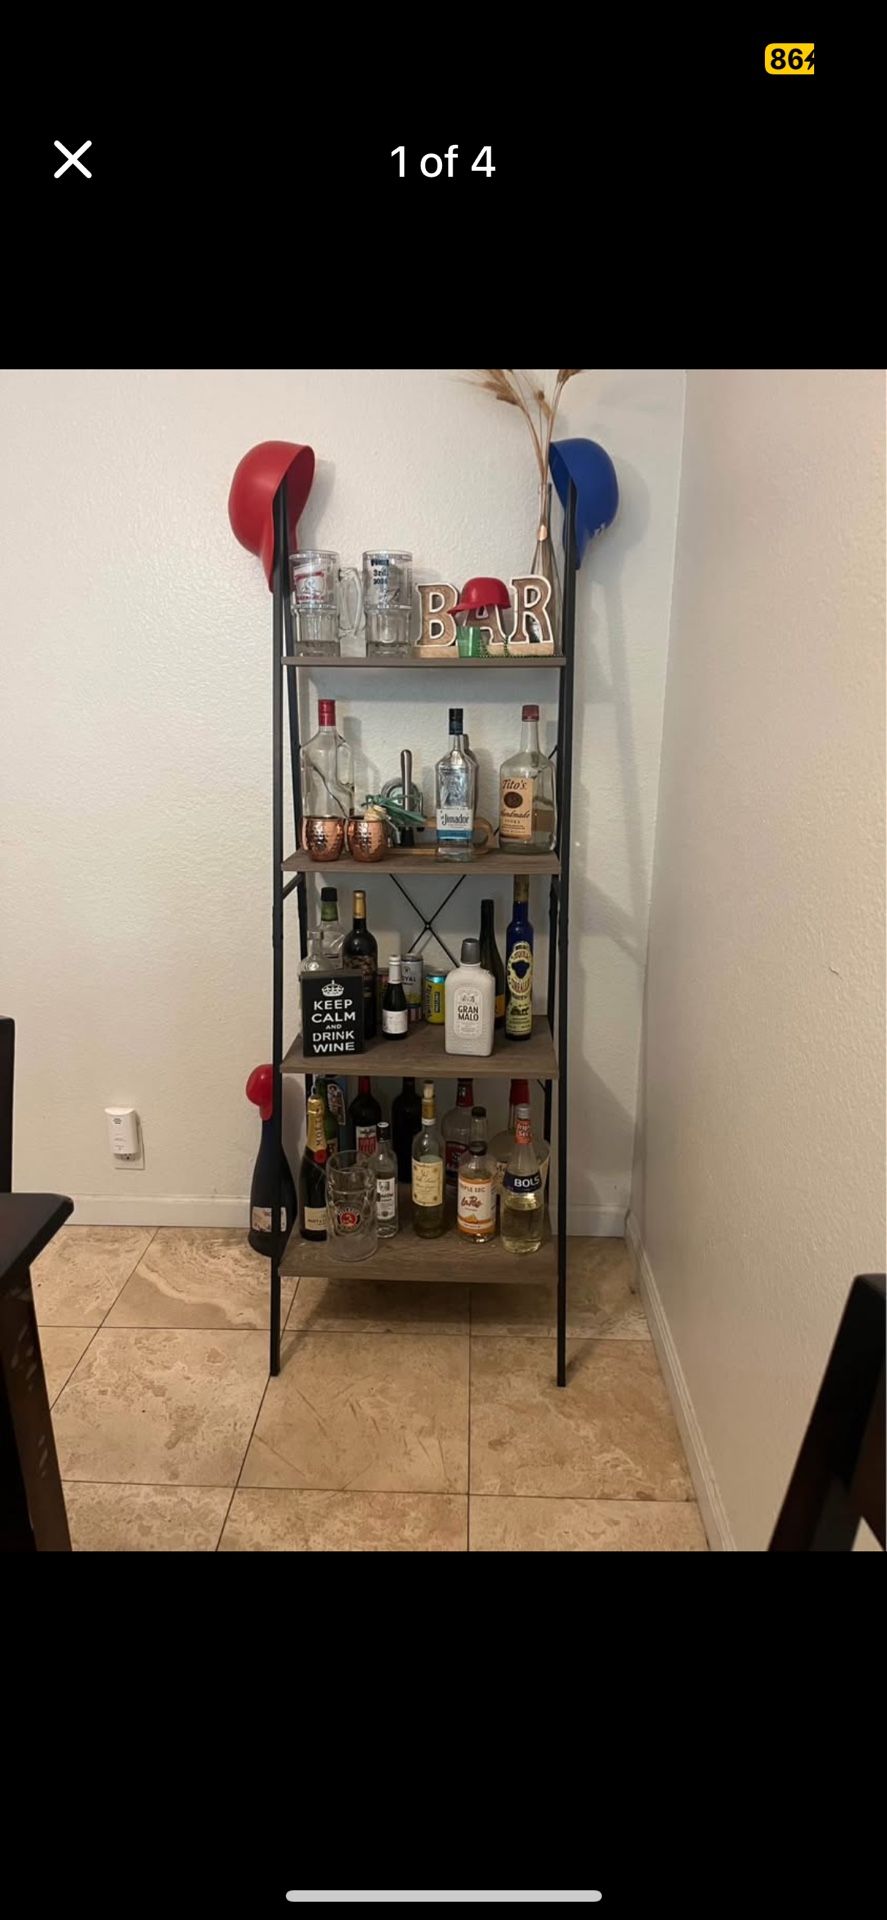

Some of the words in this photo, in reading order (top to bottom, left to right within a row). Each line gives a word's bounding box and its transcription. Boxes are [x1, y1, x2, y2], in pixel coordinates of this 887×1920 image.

[414, 575, 554, 647] BAR
[502, 778, 527, 790] Tito's
[313, 999, 353, 1011] KEEP
[457, 1005, 479, 1014] GRAN
[311, 1011, 356, 1023] CALM
[458, 1013, 479, 1021] MALO
[312, 1030, 355, 1042] DRINK
[312, 1041, 356, 1054] WINE
[513, 1176, 540, 1188] BOLS
